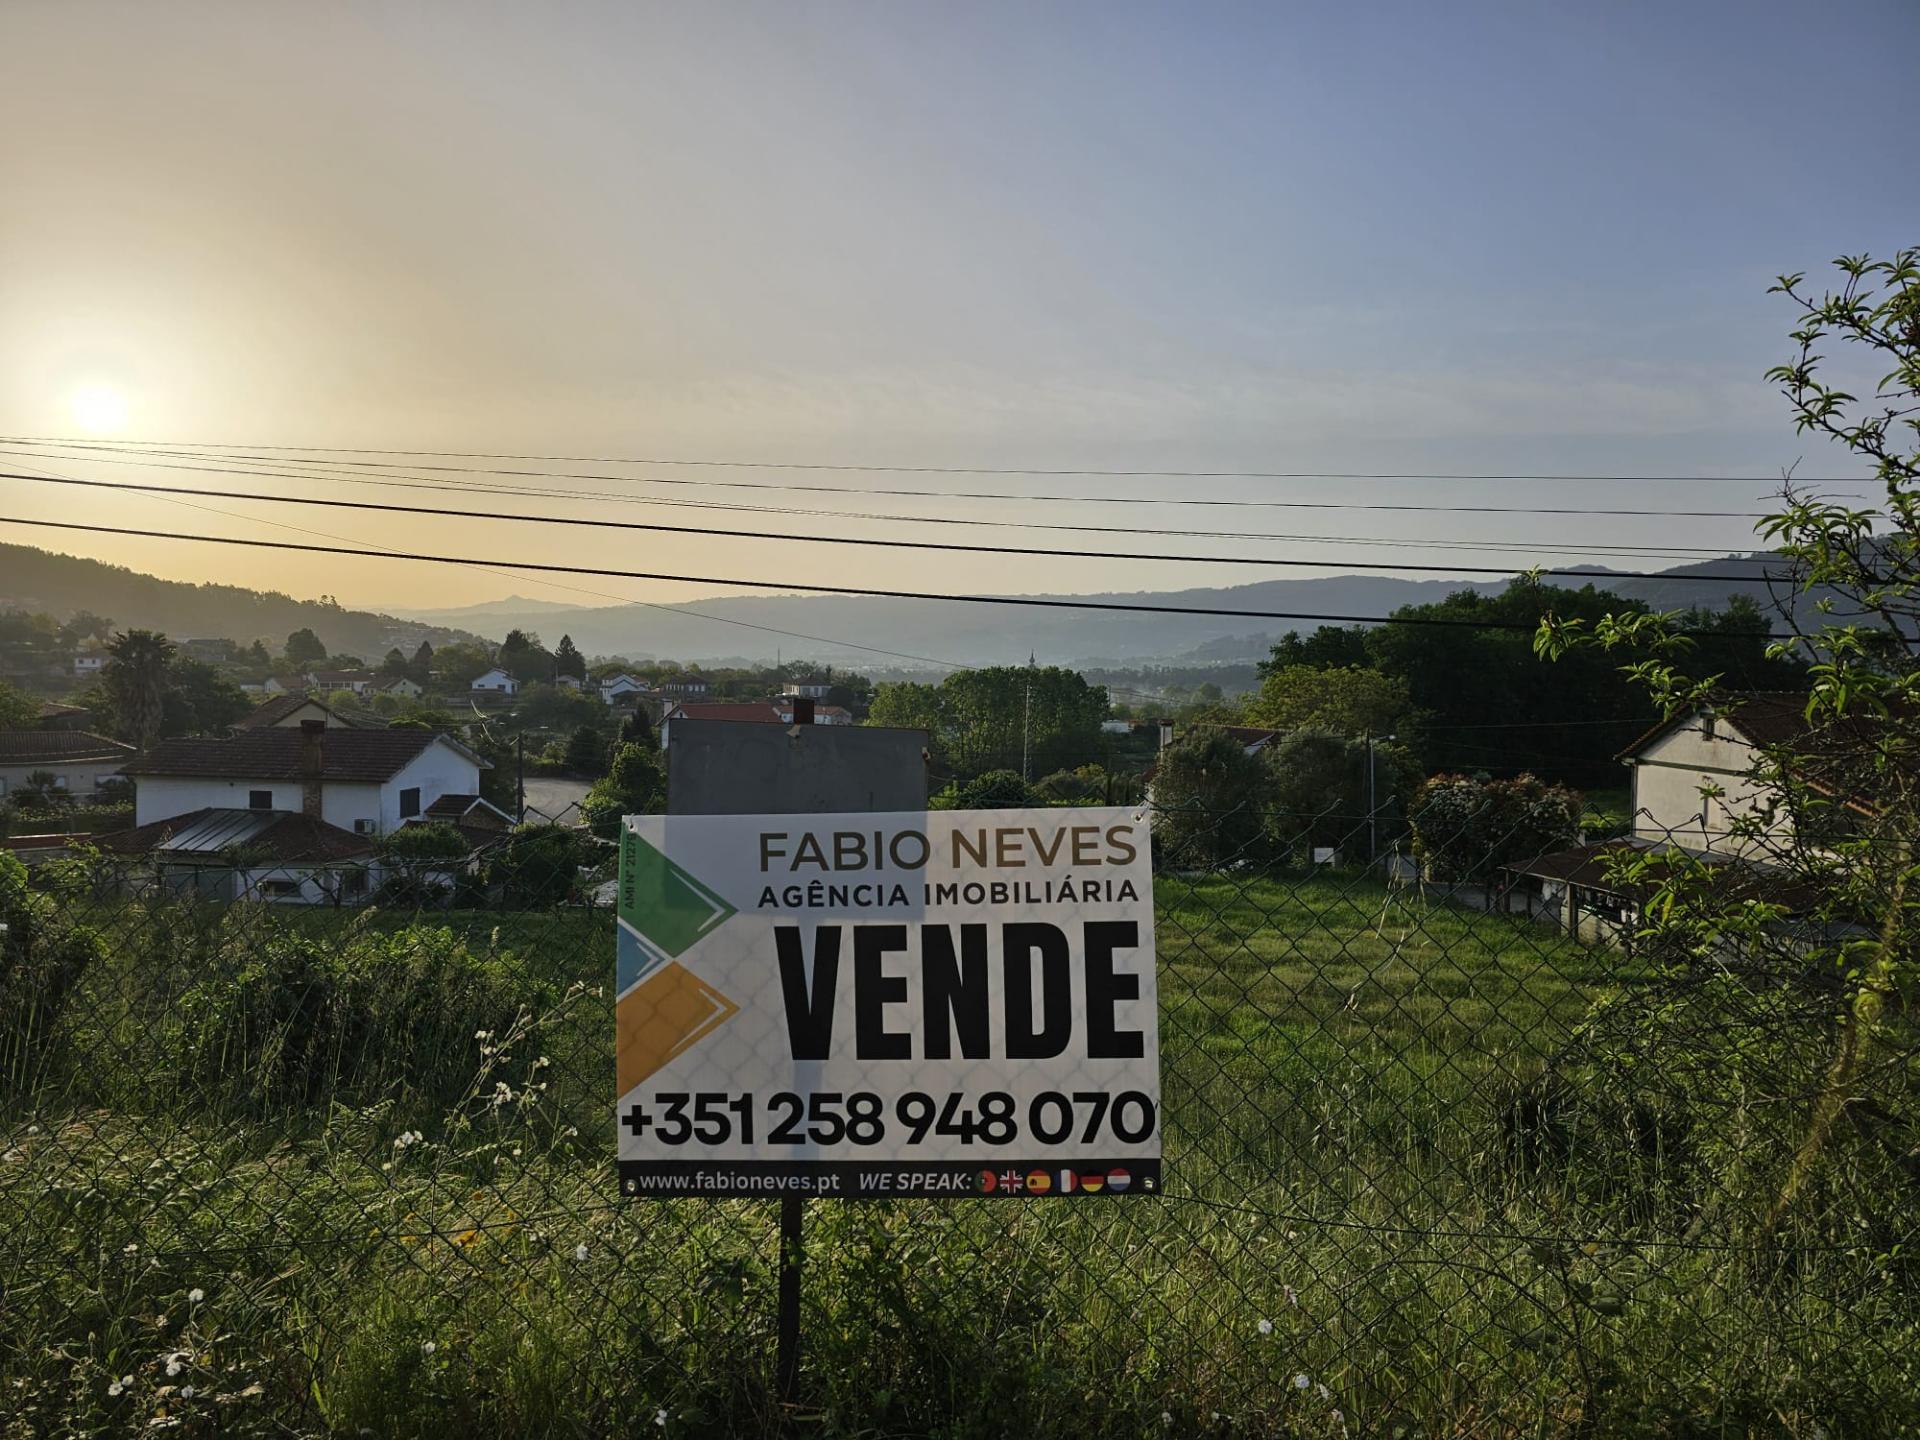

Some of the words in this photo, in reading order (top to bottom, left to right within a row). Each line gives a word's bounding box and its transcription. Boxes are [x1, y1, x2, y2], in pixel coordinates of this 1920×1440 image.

[760, 829, 931, 872] FABIO
[952, 825, 1137, 868] NEVES
[624, 887, 634, 909] AMI
[757, 878, 910, 908] AGÊNCIA
[924, 874, 1139, 905] IMOBILIÁRIA
[774, 920, 1145, 1061] VENDE
[621, 1092, 754, 1146] +351
[767, 1091, 886, 1146] 258
[896, 1091, 1018, 1145] 948
[1028, 1090, 1156, 1145] 070
[639, 1171, 840, 1194] www.fabioneves.pt
[859, 1173, 891, 1190] WE
[896, 1173, 972, 1190] SPEAK:
